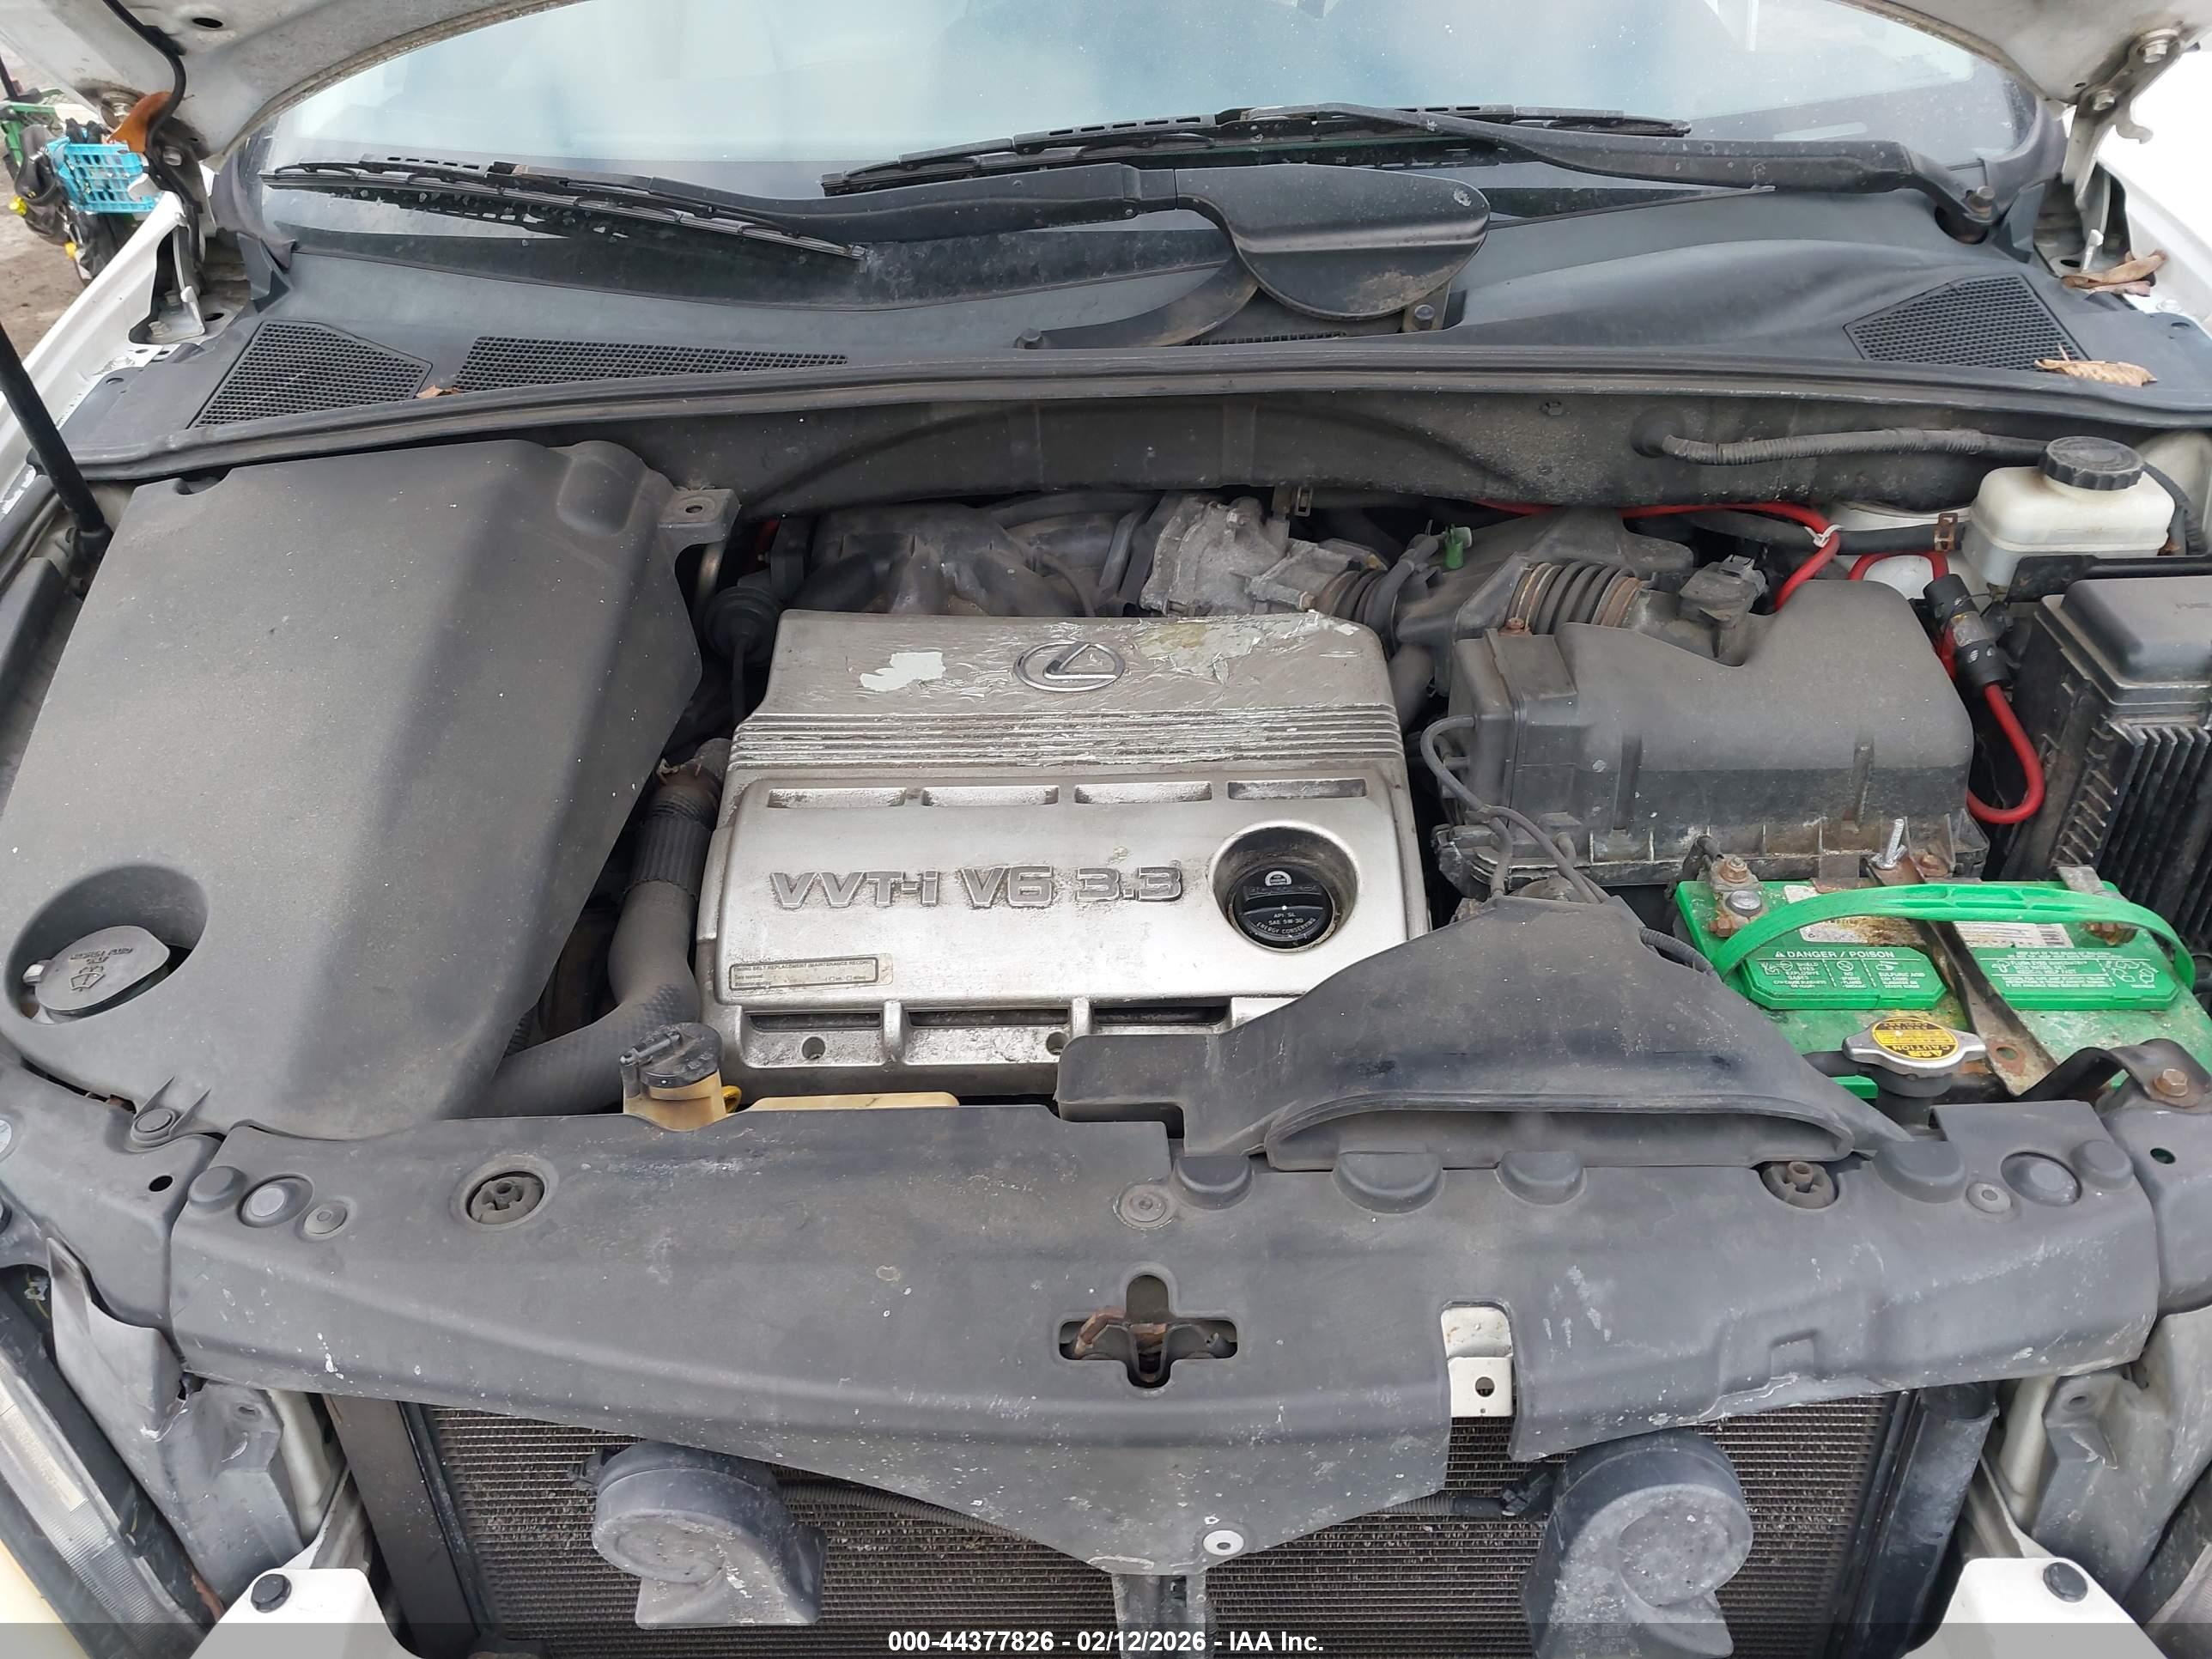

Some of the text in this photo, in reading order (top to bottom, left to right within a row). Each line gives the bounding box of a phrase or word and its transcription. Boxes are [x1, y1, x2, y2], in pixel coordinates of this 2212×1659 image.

[771, 866, 1183, 908] VVT-i V6 3.3
[1256, 917, 1316, 934] ENERGY CONSERVING
